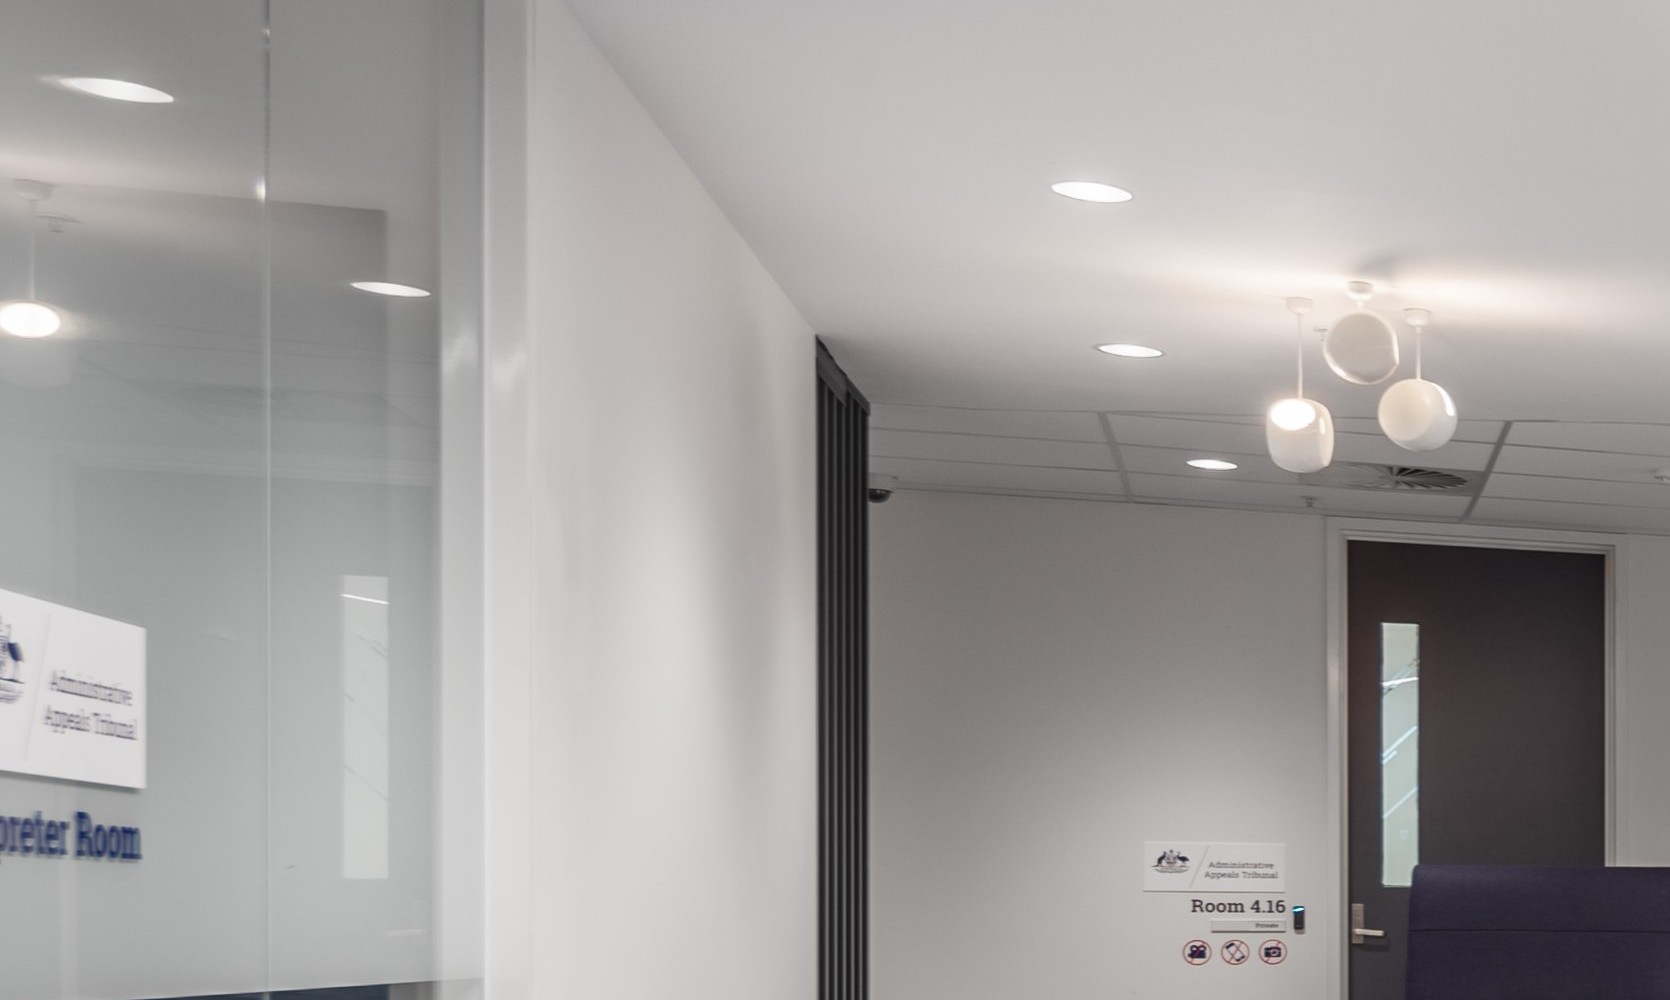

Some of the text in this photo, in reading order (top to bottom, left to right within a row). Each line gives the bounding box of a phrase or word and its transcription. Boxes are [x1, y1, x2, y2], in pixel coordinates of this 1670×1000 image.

[50, 669, 134, 707] Administrative
[44, 704, 138, 741] Appeals Tribunal
[74, 810, 143, 862] Room
[1204, 870, 1279, 880] Appeals Tribunal
[1208, 861, 1275, 870] Administrative
[1191, 898, 1287, 914] Room 4.16
